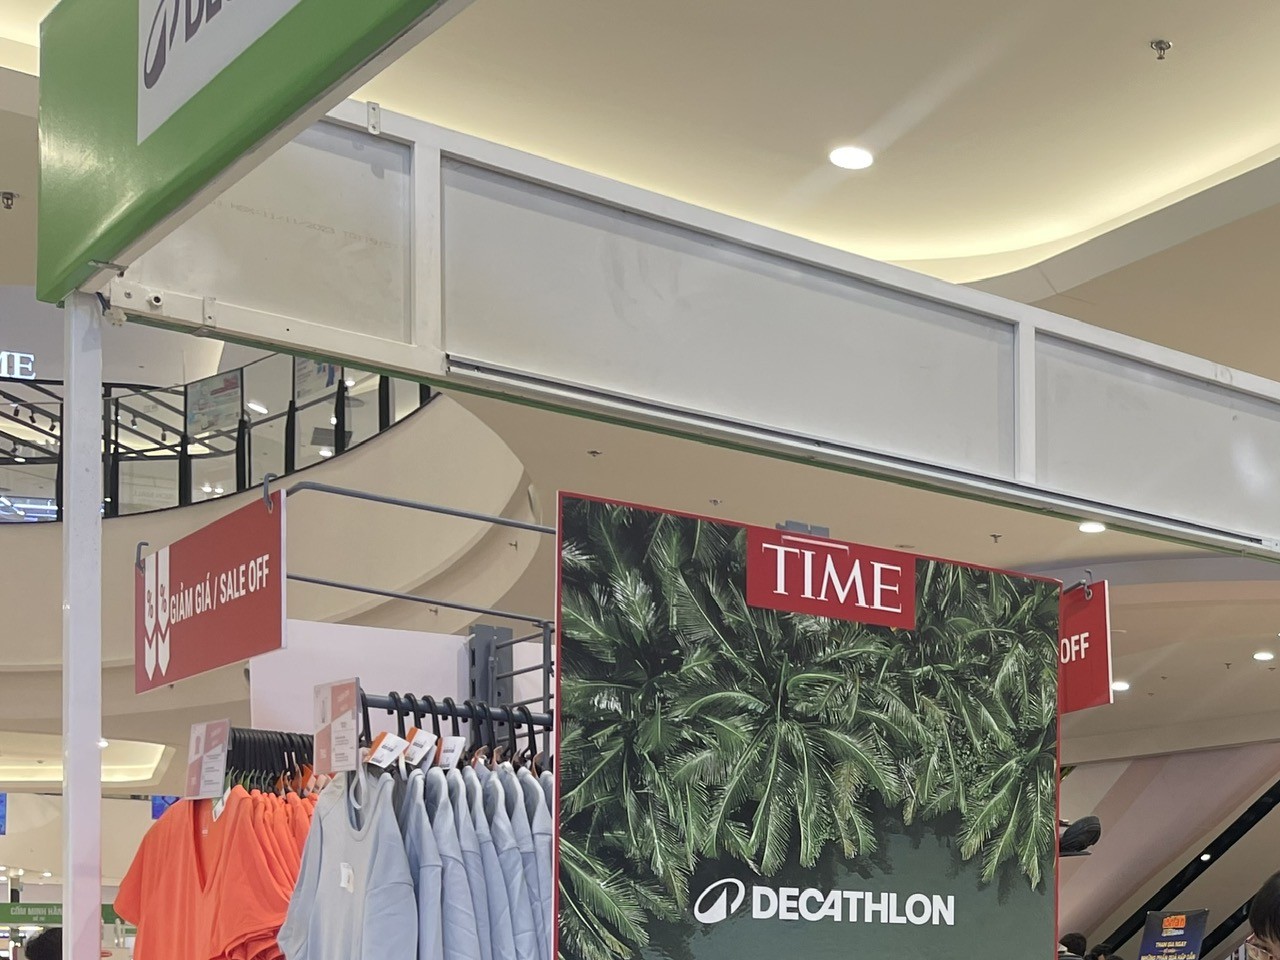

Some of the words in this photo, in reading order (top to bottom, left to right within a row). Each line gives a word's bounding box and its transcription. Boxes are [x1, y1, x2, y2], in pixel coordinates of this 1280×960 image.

[170, 582, 193, 624] GIẢM
[196, 572, 212, 614] GIÁ
[220, 564, 245, 604] SALE
[248, 554, 269, 592] OFF
[762, 543, 901, 613] TIME
[1060, 632, 1089, 664] OFF
[752, 886, 954, 926] DECATHLON
